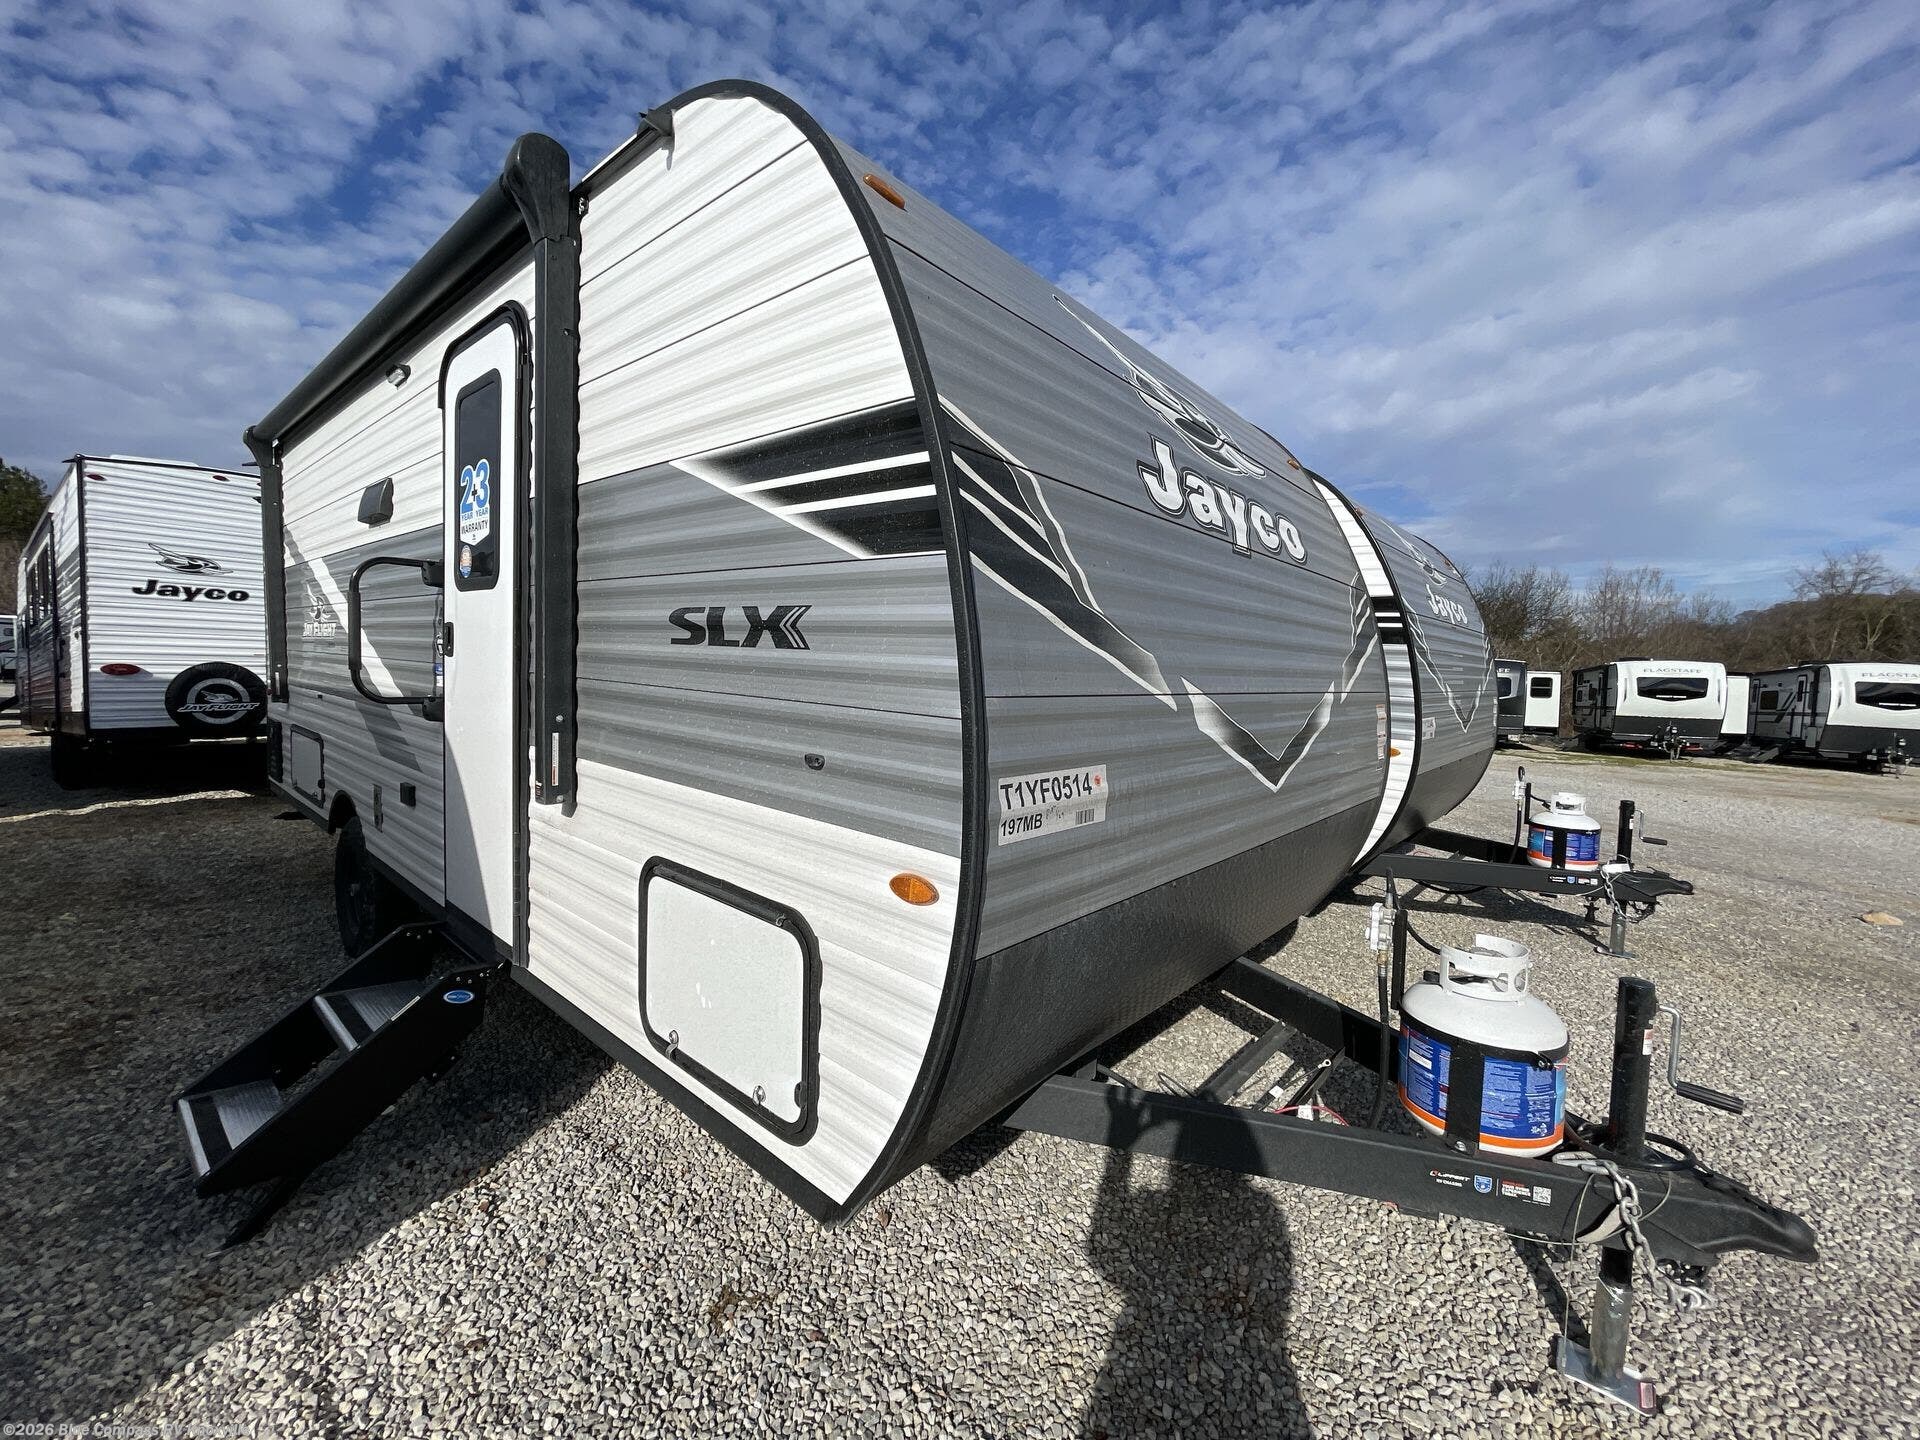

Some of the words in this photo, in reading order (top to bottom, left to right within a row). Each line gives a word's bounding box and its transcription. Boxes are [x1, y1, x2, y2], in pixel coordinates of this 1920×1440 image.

[1136, 432, 1308, 565] Jayco
[461, 512, 474, 522] YEAR
[476, 506, 489, 518] YEAR
[461, 519, 489, 535] WARRANTY
[132, 578, 250, 602] Jayco
[1426, 583, 1468, 624] Jayco
[668, 605, 812, 650] SLX
[177, 703, 208, 712] JAY
[205, 702, 260, 712] FLIGHT
[1000, 772, 1092, 810] T1YF0514
[1001, 813, 1043, 837] 197MB
